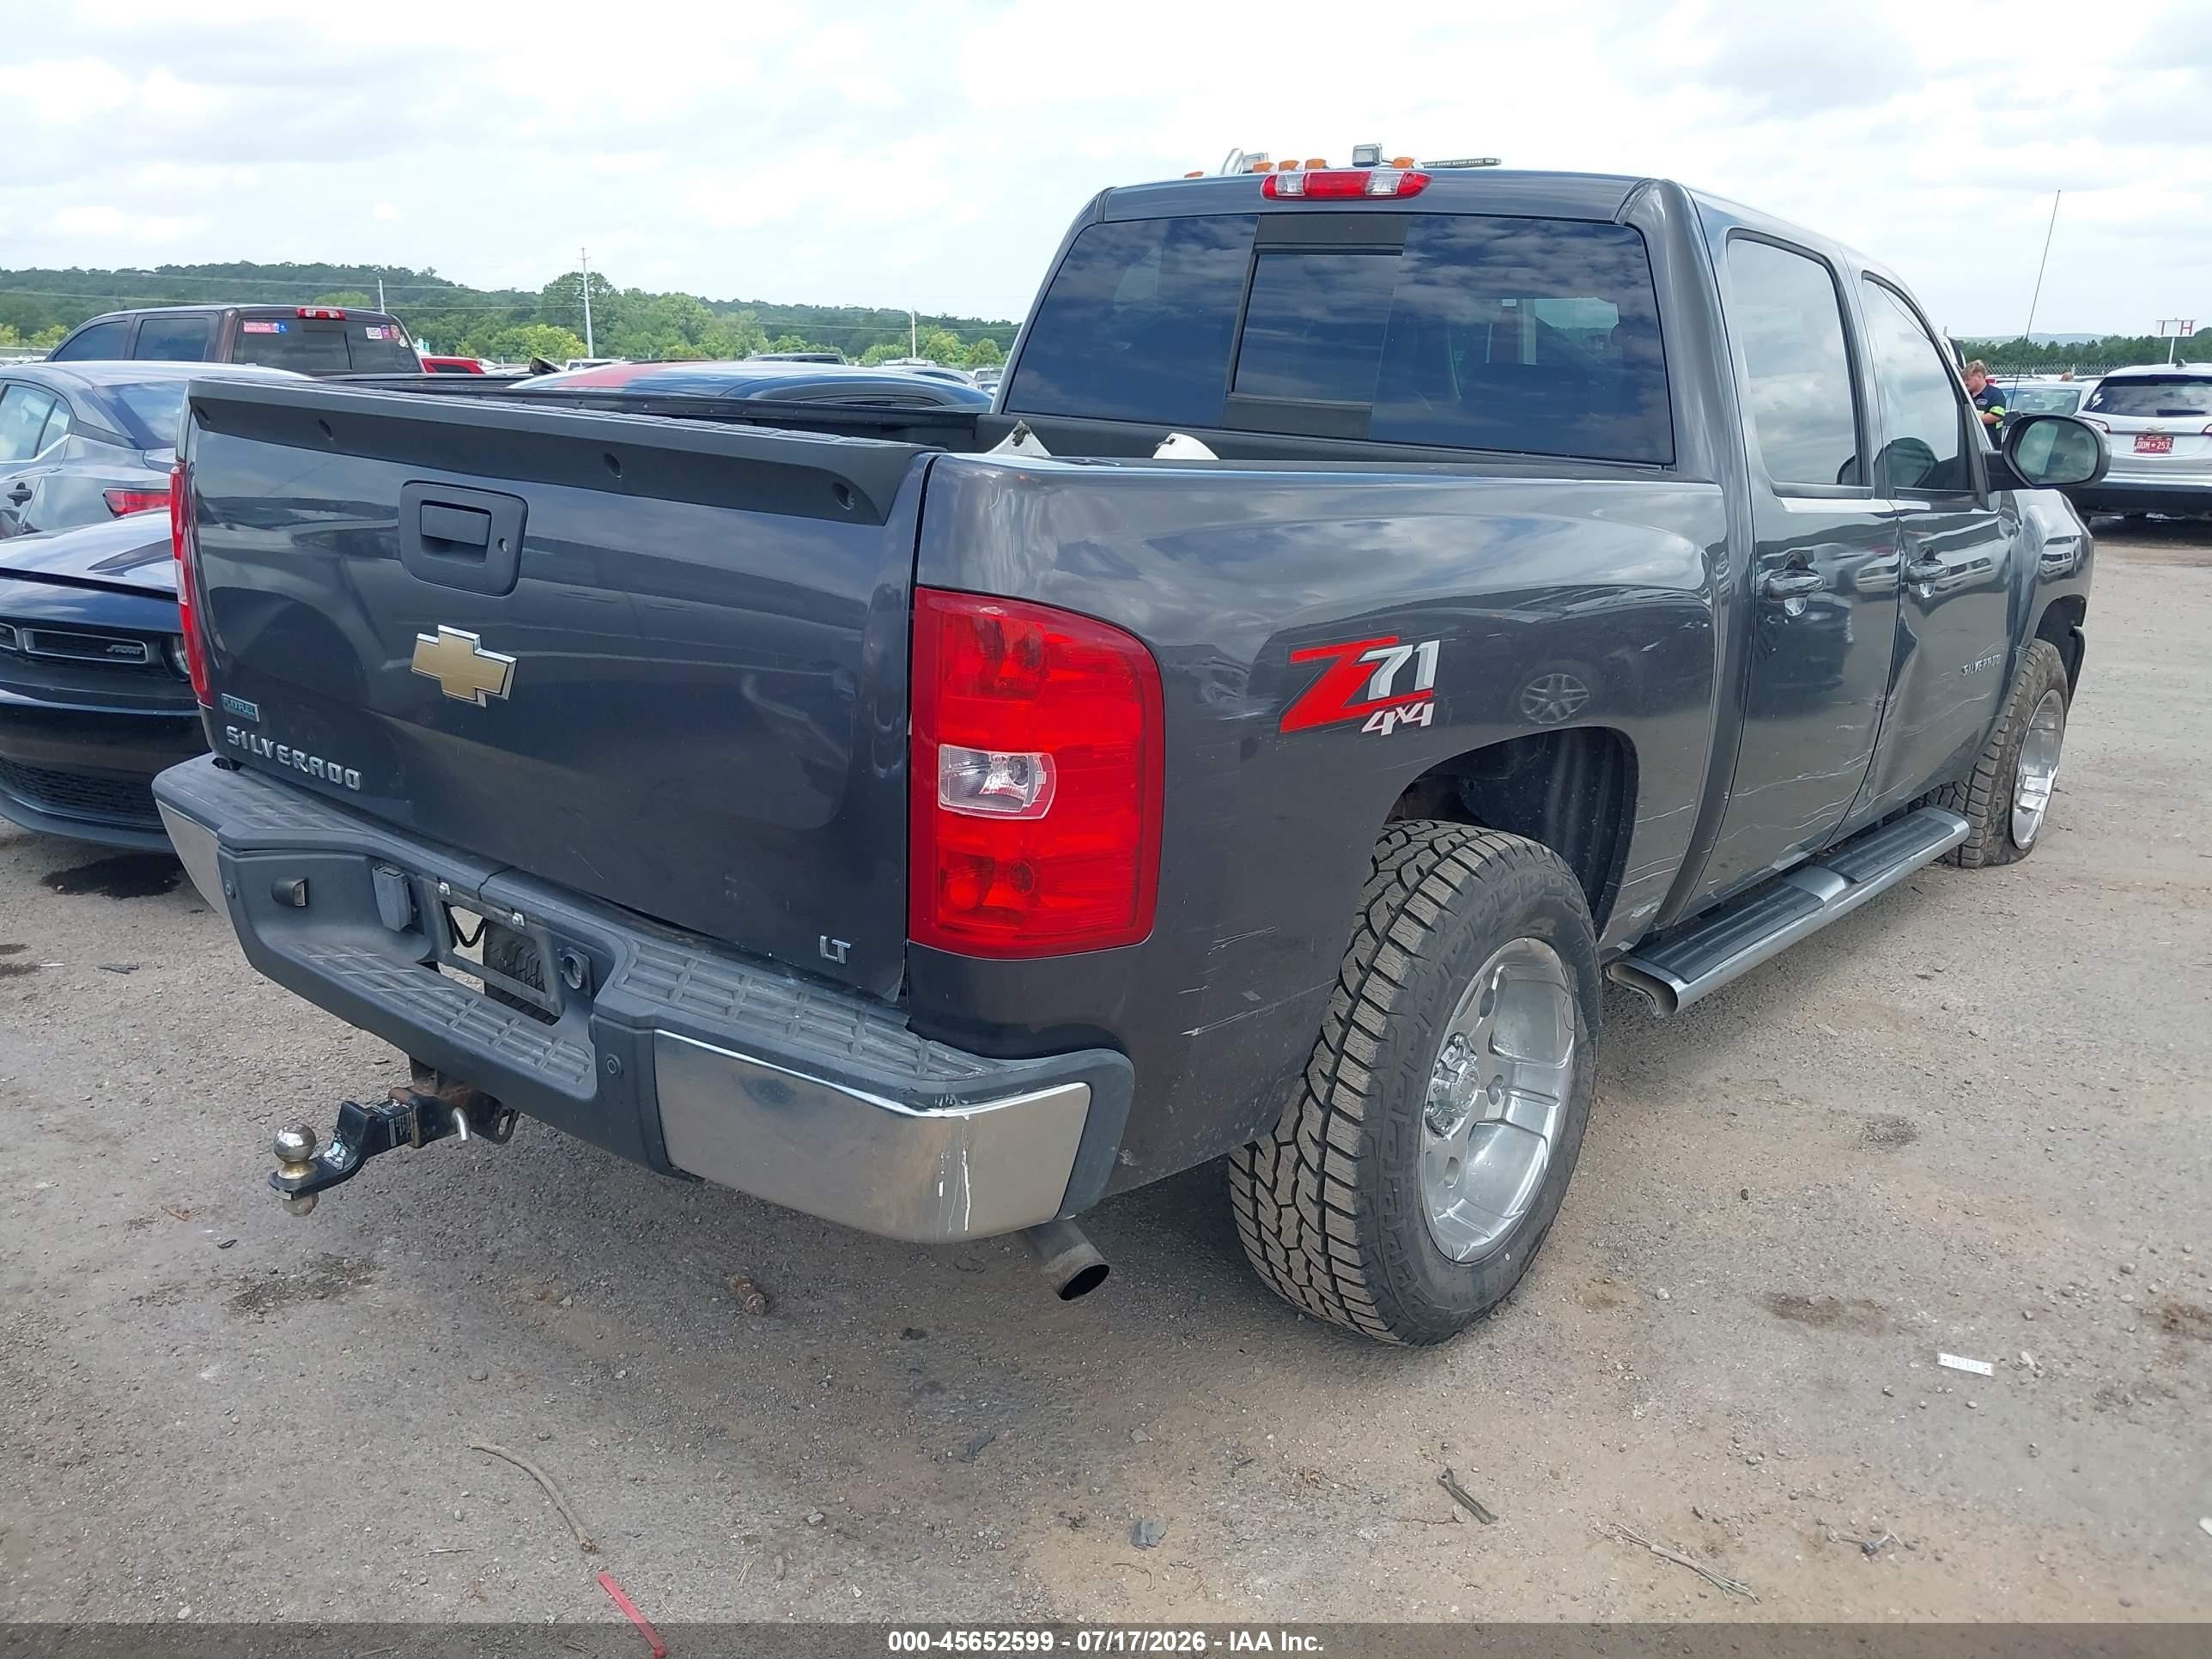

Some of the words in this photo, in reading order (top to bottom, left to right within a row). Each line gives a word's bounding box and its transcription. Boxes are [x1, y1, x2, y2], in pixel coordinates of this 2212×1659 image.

[2156, 441, 2171, 450] 253
[1279, 635, 1441, 734] Z71
[226, 725, 362, 791] SILVERADO
[819, 935, 852, 964] LT
